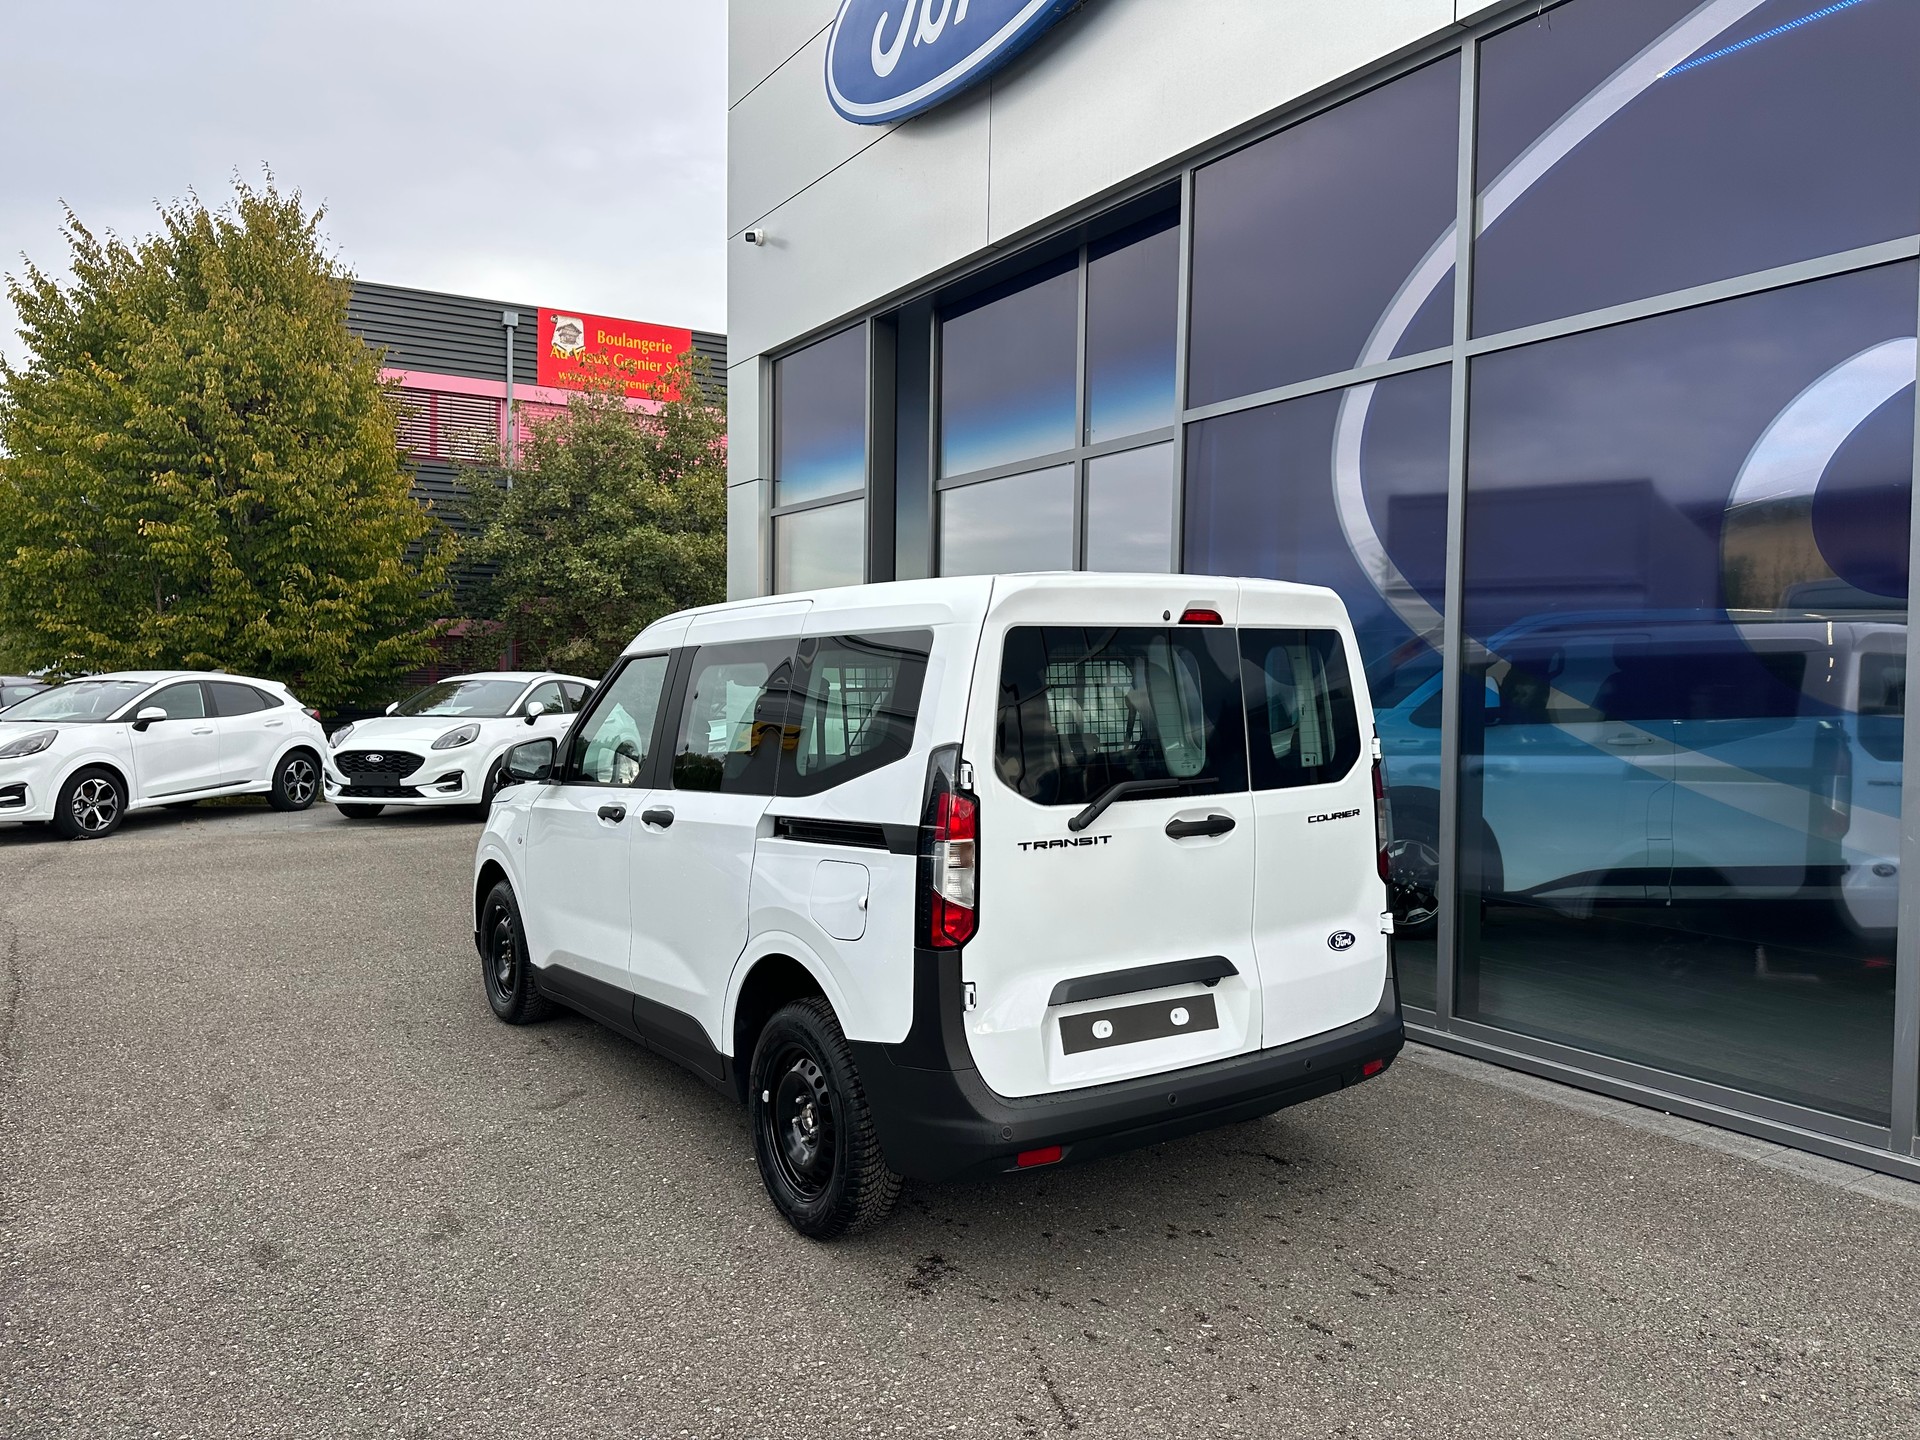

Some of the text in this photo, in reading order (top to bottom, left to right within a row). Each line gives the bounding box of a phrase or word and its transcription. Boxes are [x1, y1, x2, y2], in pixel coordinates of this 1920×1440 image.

[597, 330, 673, 354] Boulangerie
[550, 345, 568, 360] Au
[1307, 808, 1360, 823] COURIER
[1017, 835, 1112, 851] TRANSIT
